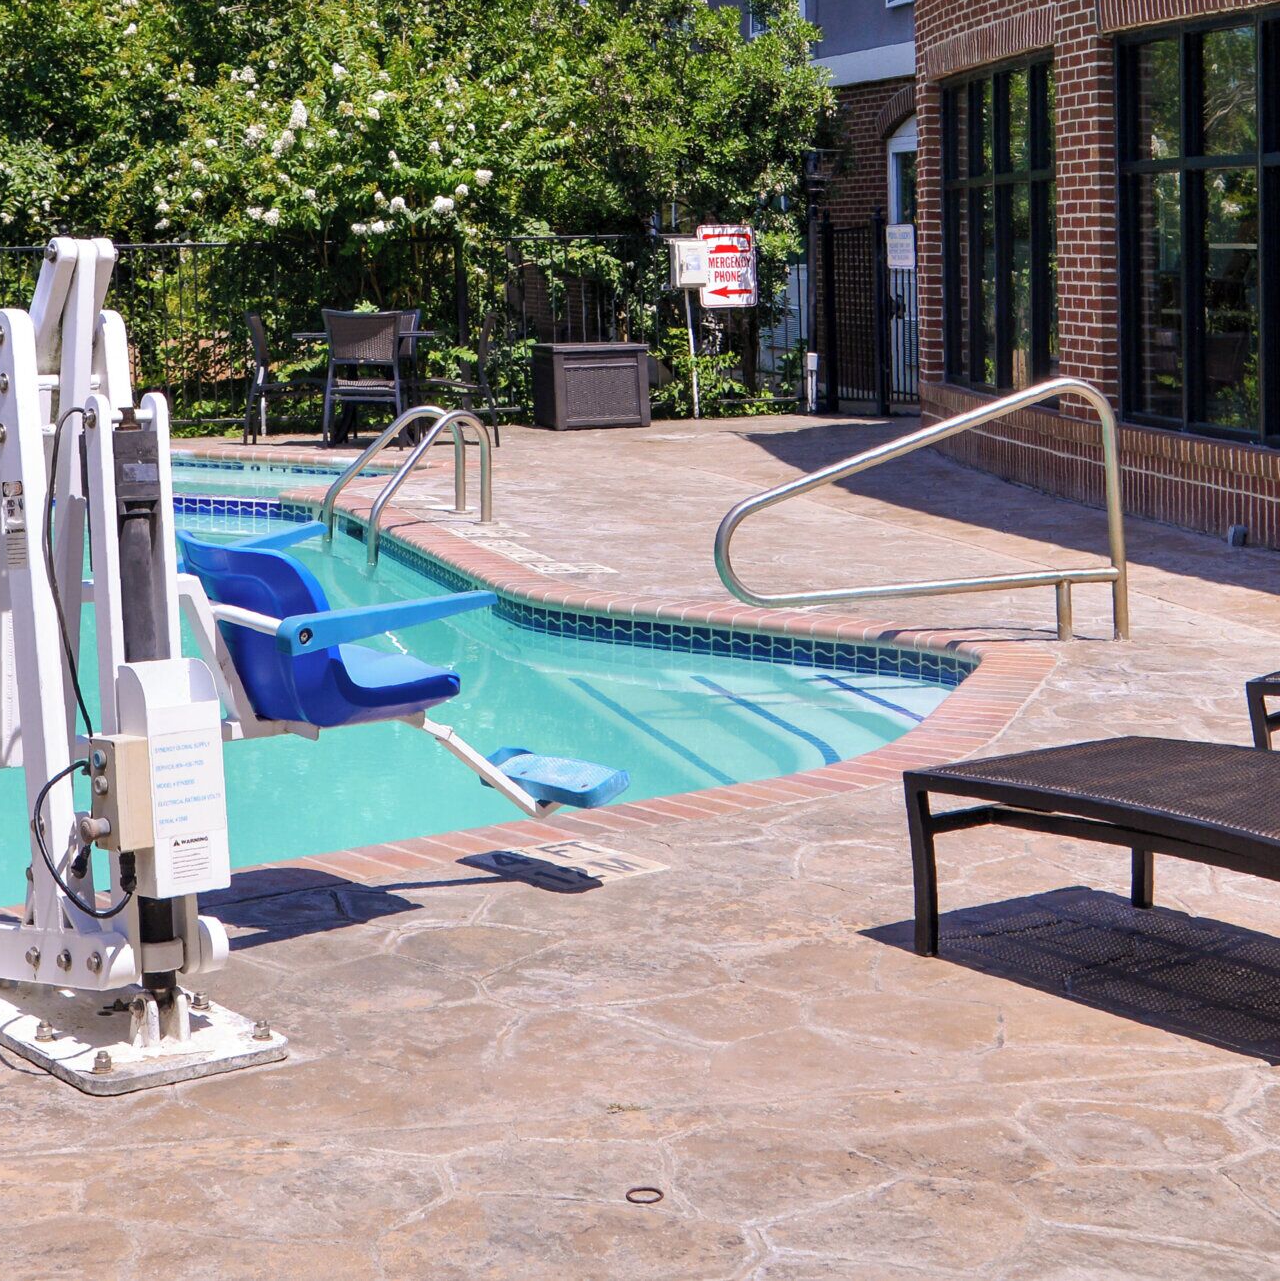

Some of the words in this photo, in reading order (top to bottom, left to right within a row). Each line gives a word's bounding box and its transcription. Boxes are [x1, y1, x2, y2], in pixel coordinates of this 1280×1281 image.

[708, 256, 751, 269] MERGENCY
[714, 271, 742, 283] PHONE
[181, 836, 208, 844] WARNING
[491, 849, 532, 866] 4
[535, 841, 601, 859] FT
[588, 857, 648, 874] M
